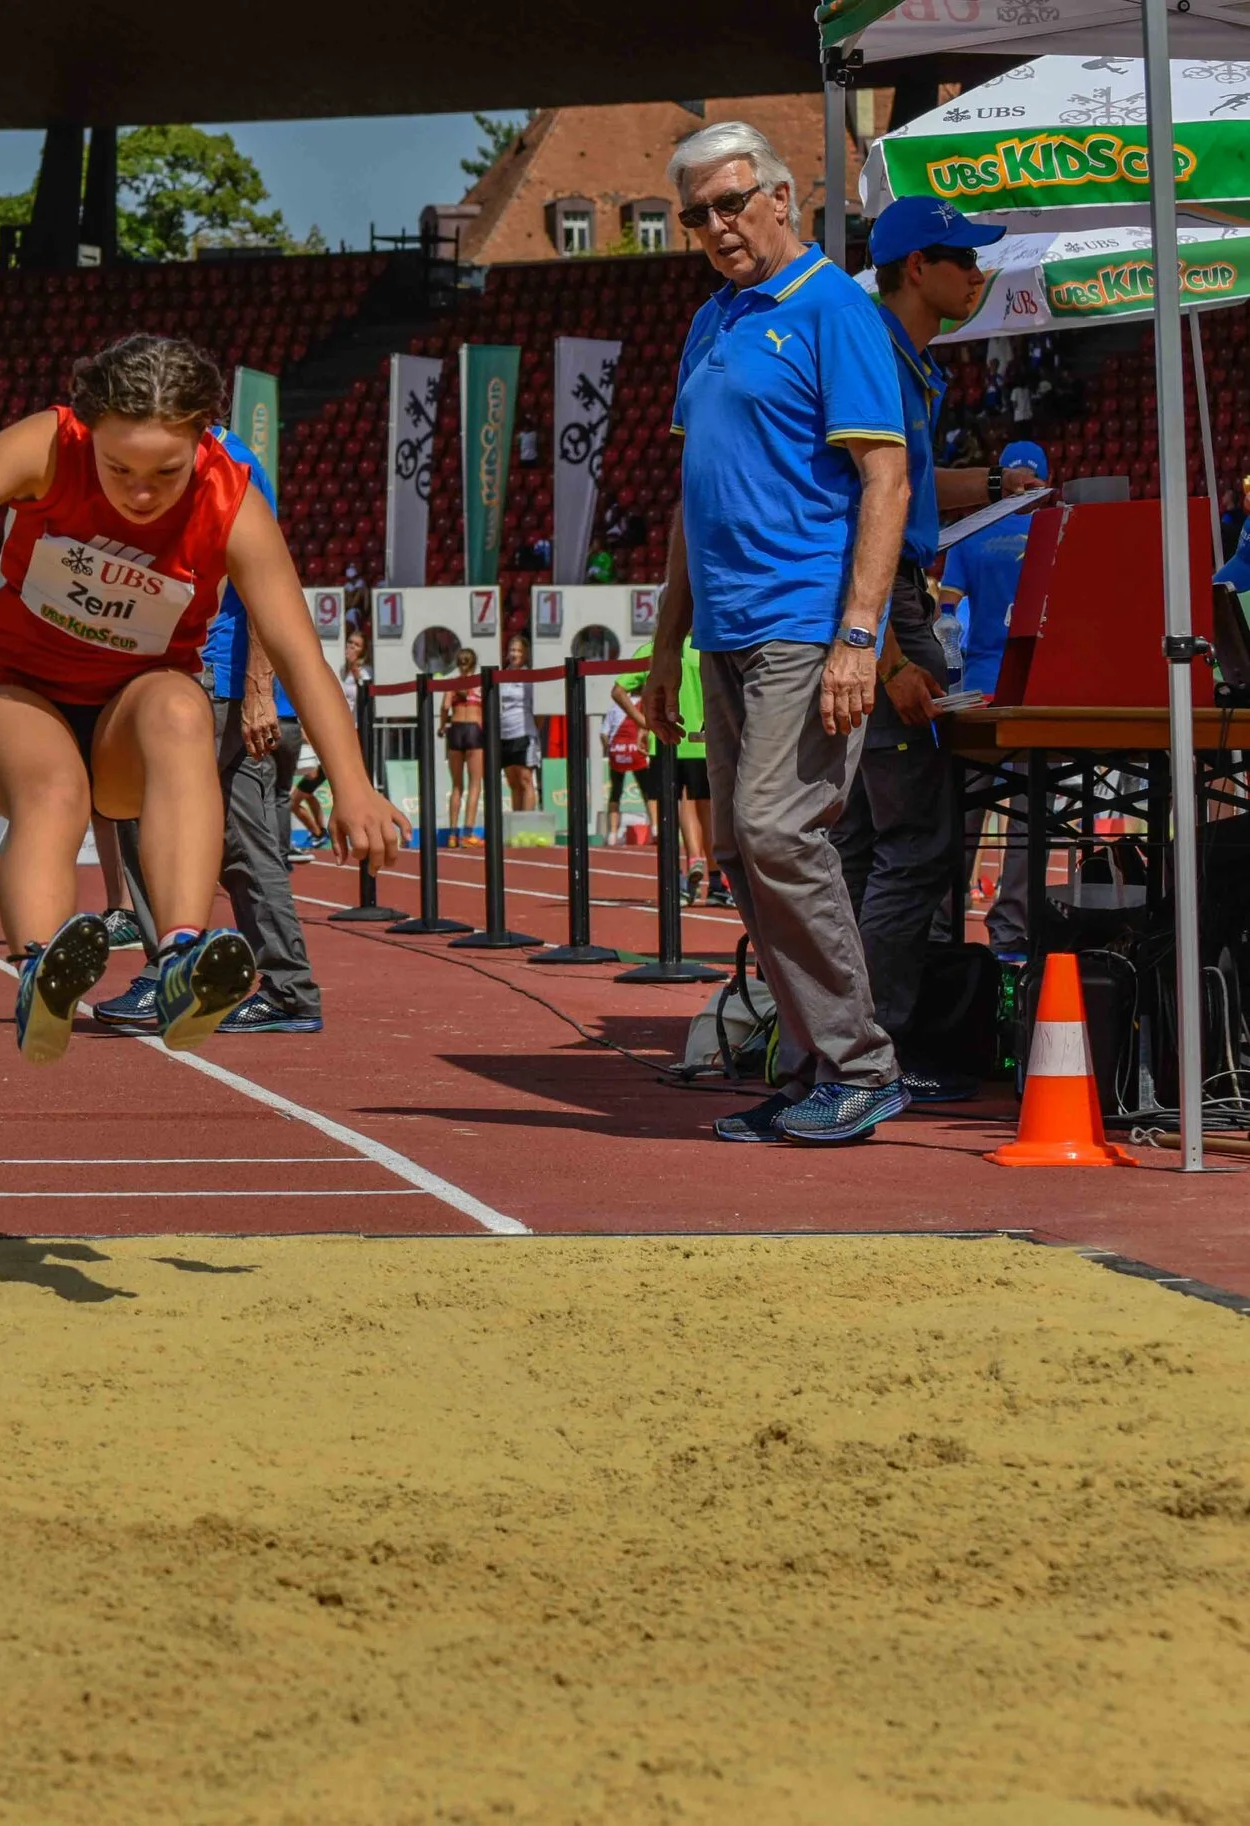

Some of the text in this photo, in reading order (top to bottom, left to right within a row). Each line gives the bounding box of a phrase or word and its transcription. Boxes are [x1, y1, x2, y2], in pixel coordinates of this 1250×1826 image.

[976, 106, 1026, 119] UBS
[932, 138, 1191, 193] UBS KIDS CP
[1085, 238, 1120, 250] UBS
[1054, 282, 1100, 307] UBS
[1184, 266, 1234, 290] CUP
[101, 560, 164, 595] UBS
[66, 580, 136, 619] Zeni
[318, 594, 338, 625] 9
[382, 590, 492, 625] 1 7
[544, 591, 654, 624] 1 5
[40, 604, 138, 650] UBS KIDS CUP
